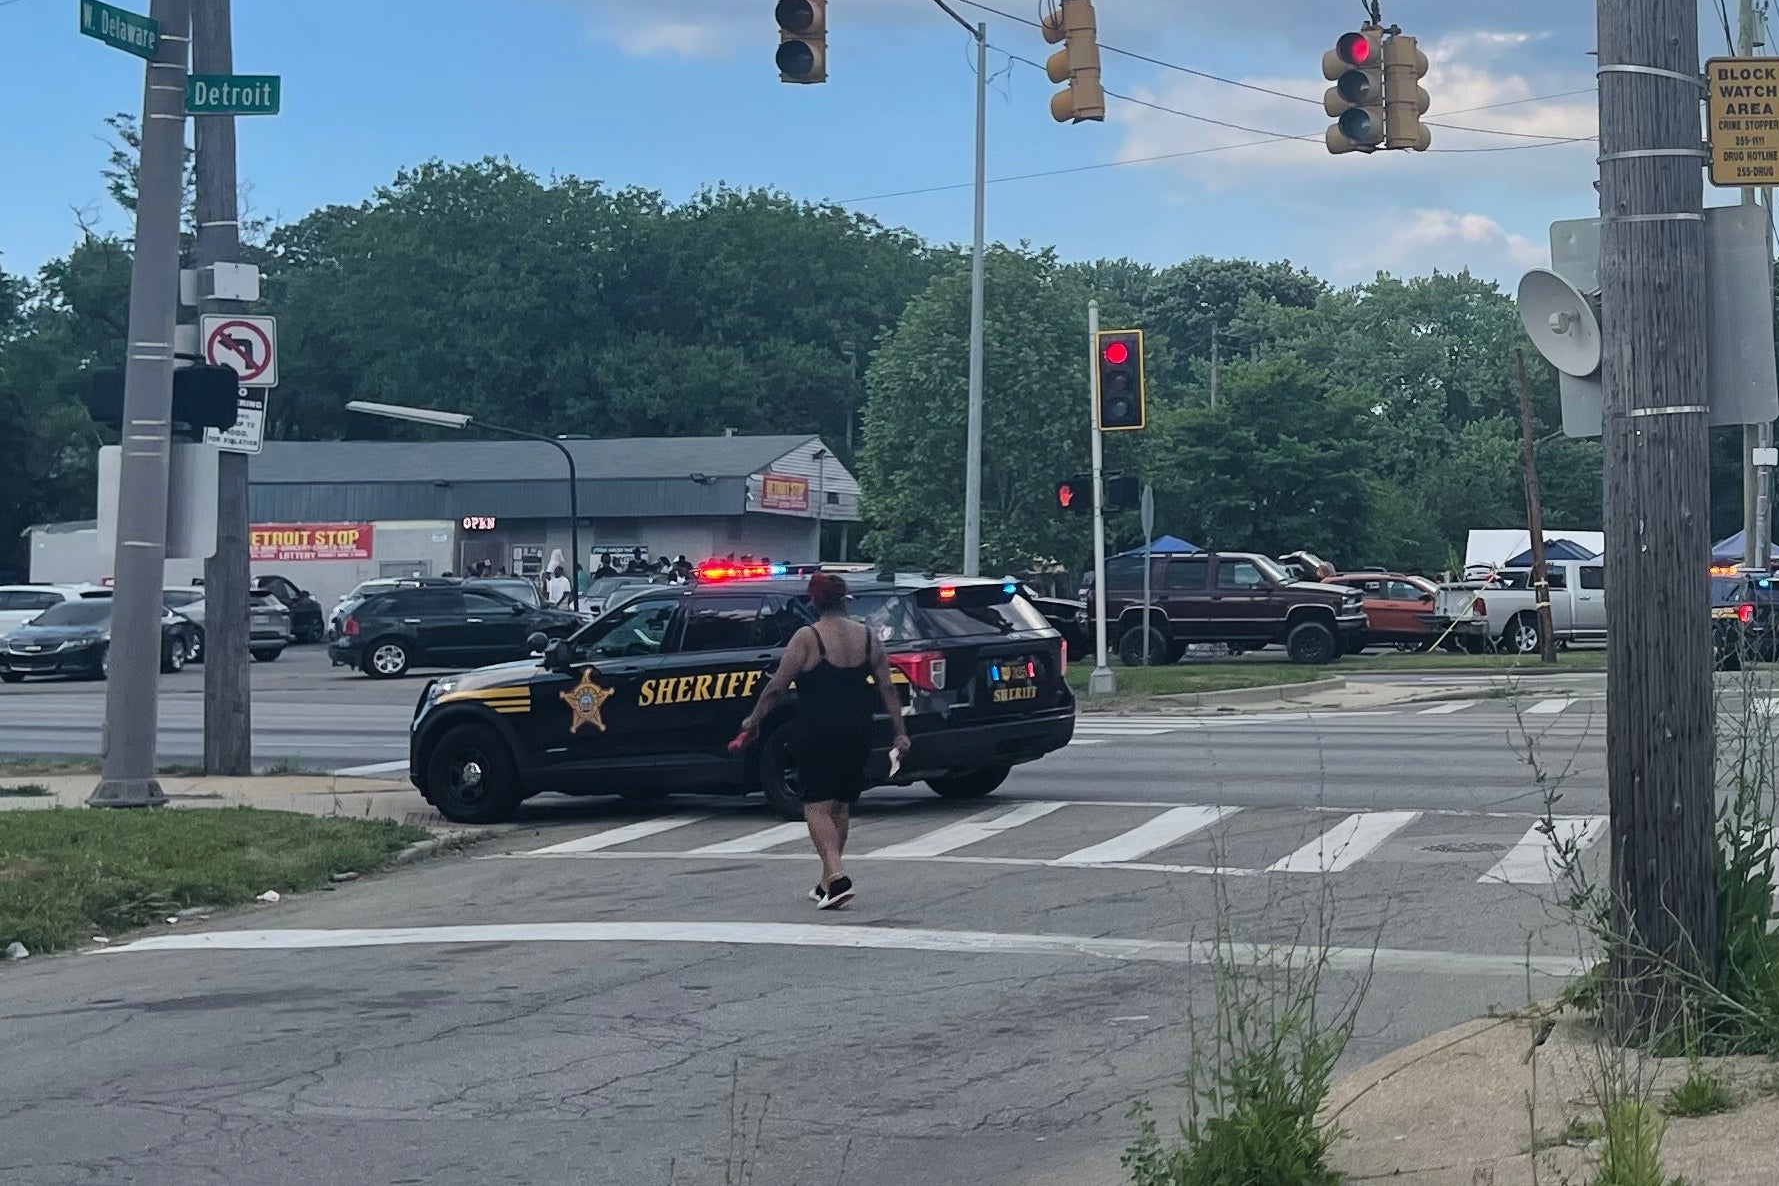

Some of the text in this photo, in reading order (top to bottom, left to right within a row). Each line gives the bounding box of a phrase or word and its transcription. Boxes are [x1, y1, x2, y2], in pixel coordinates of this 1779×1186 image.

[101, 10, 156, 50] Delaware
[1718, 68, 1776, 80] BLOCK
[194, 81, 272, 107] Detroit
[1720, 86, 1777, 98] WATCH
[1726, 103, 1773, 115] AREA
[1718, 120, 1779, 131] CRIME STOPPER
[1723, 151, 1779, 162] DRUG HOTLINE
[463, 516, 496, 530] OPEN
[249, 529, 360, 546] ETROIT STOP
[638, 670, 763, 707] SHERIFF
[993, 685, 1038, 702] SHERIFF
